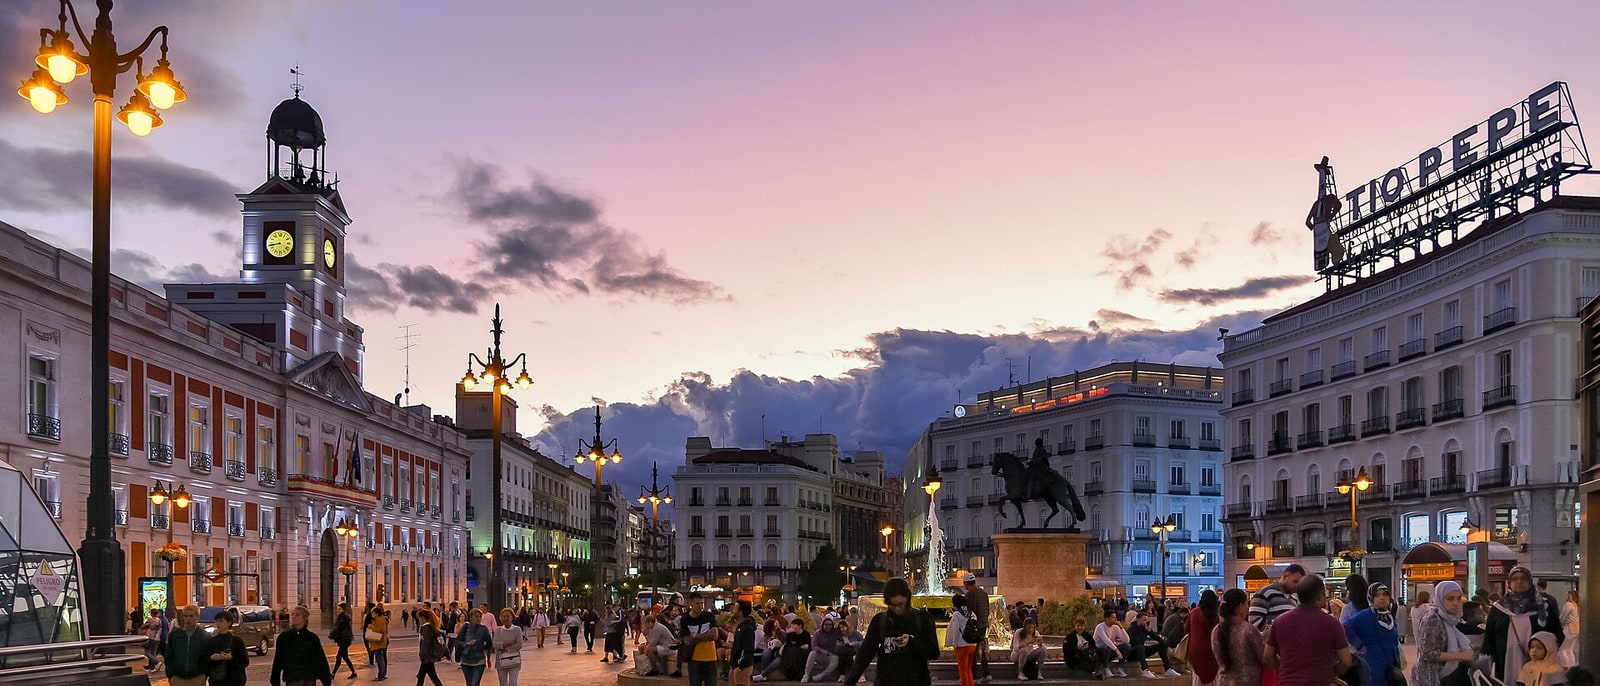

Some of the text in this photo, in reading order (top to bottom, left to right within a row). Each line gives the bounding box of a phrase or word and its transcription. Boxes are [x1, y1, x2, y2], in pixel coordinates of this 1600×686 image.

[1346, 81, 1560, 220] TIO PEPE
[36, 577, 61, 586] PELIGRO
